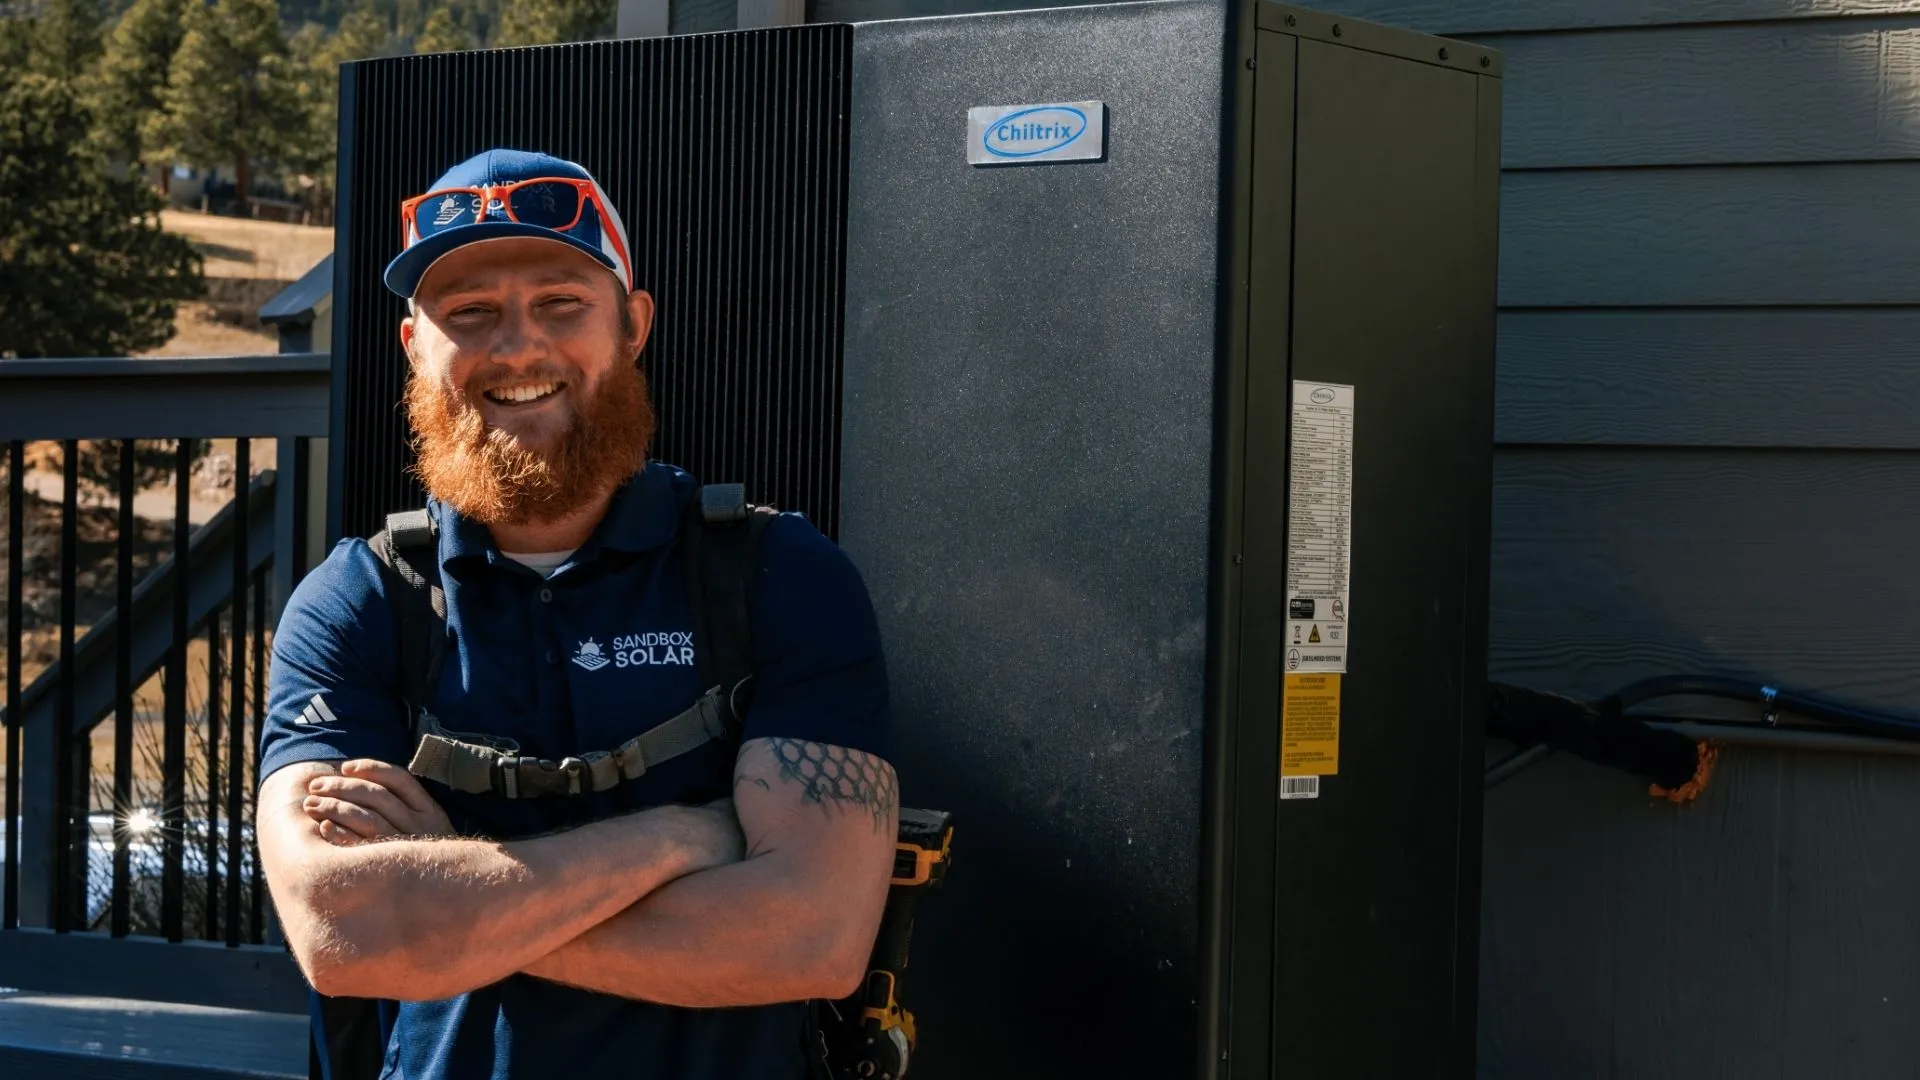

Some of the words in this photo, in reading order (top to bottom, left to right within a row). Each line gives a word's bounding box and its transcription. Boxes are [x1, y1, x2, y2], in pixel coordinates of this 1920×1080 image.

[997, 122, 1072, 142] Chiltrix
[613, 631, 694, 650] SANDBOX
[615, 645, 694, 668] SOLAR
